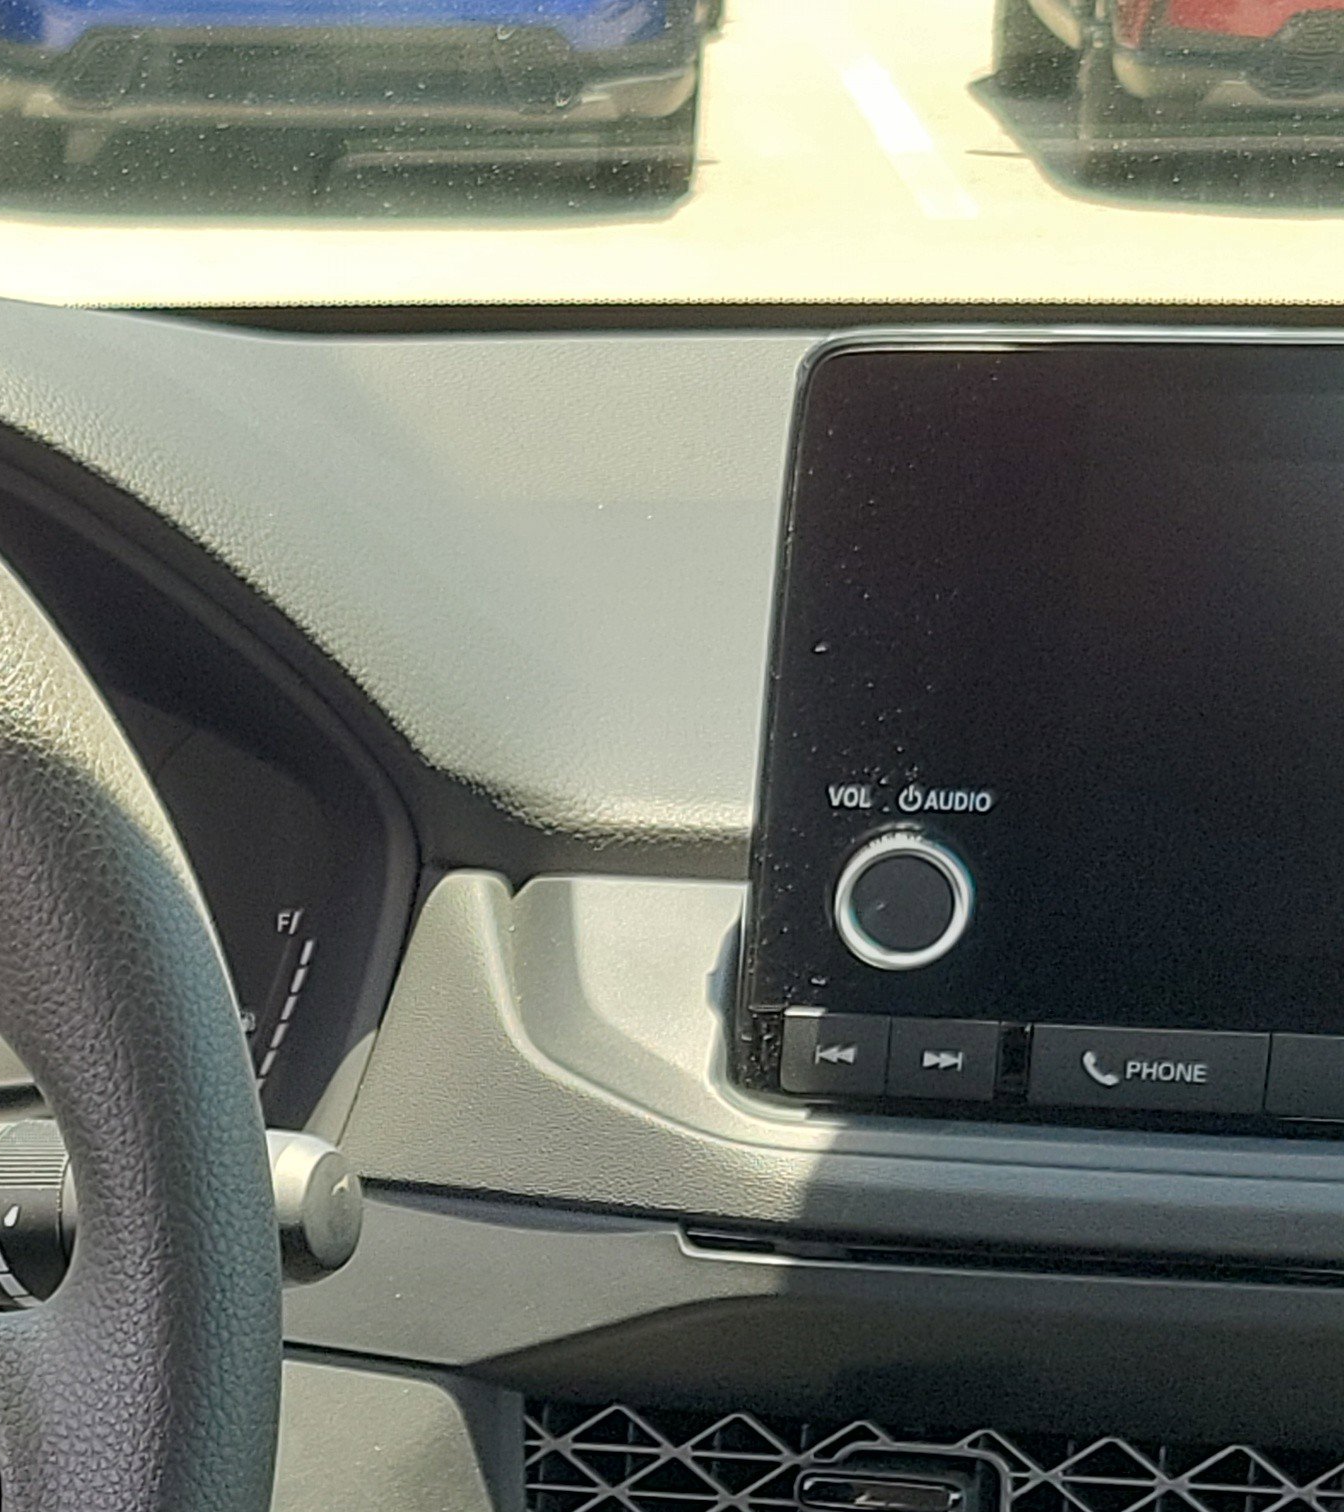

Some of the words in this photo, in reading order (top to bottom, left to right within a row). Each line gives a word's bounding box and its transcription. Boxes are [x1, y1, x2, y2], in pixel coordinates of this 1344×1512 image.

[828, 786, 871, 809] VOL
[924, 790, 992, 813] AUDIO
[1126, 1061, 1208, 1084] PHONE
